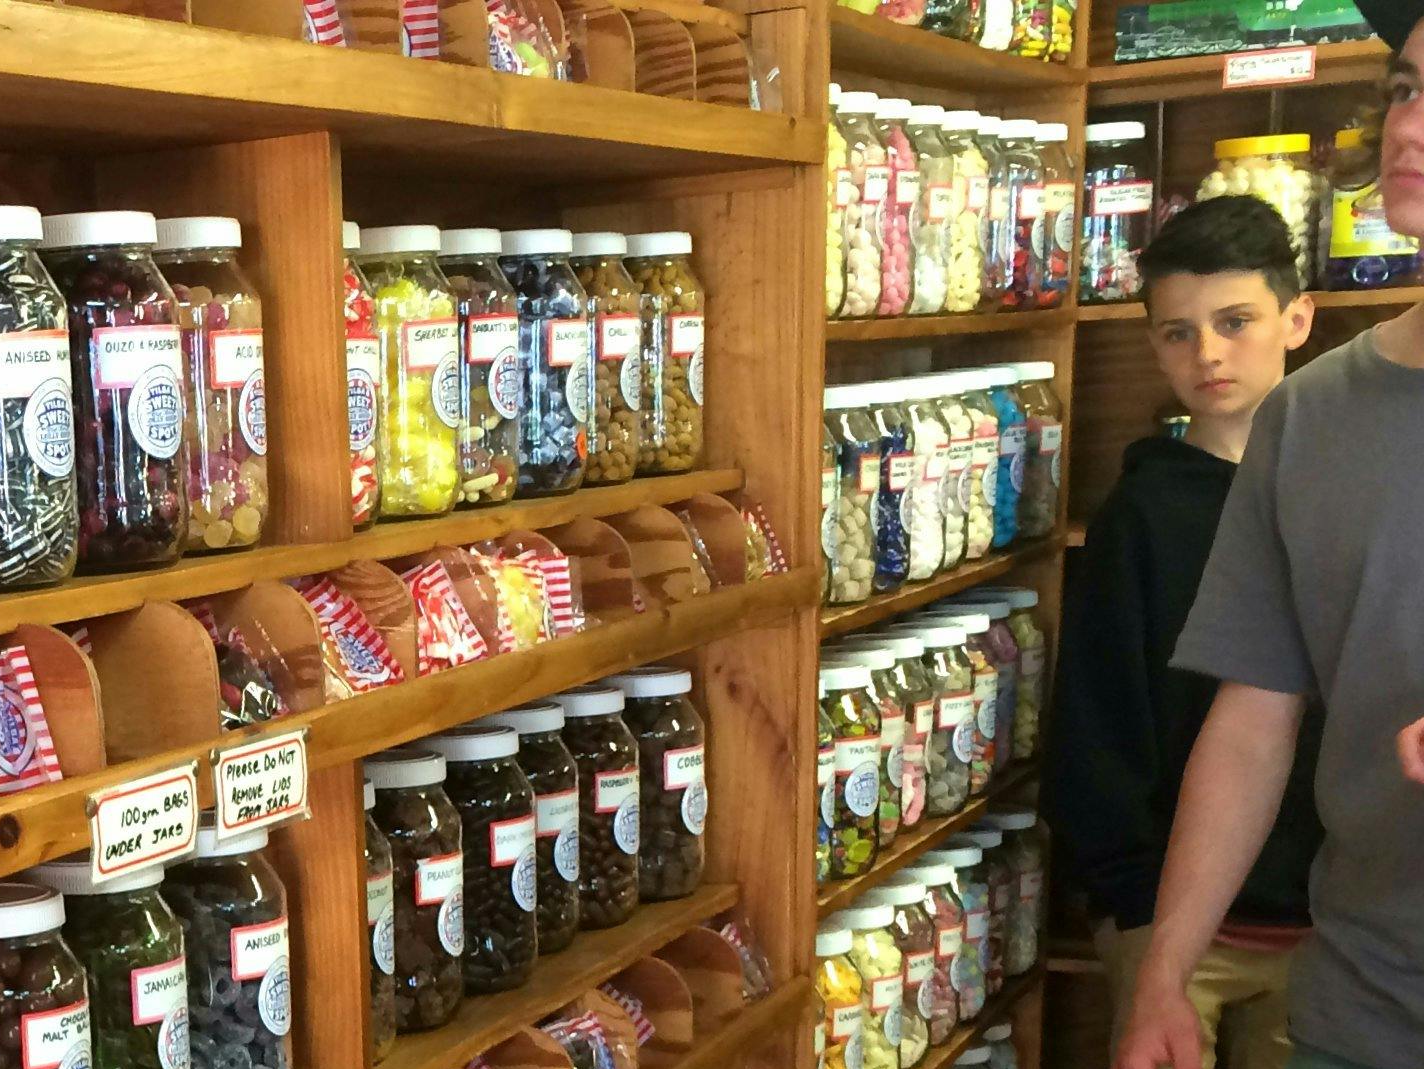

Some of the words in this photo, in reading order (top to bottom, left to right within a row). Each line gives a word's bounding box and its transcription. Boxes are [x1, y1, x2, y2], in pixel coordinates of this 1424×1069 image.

[105, 340, 135, 353] OUZO
[5, 350, 52, 364] ANISEED
[145, 395, 176, 411] SWEET
[39, 411, 70, 427] SWEET
[149, 425, 176, 440] SPOT
[350, 422, 369, 435] POT
[46, 443, 70, 458] SPOT
[231, 783, 264, 804] REMOVE
[272, 775, 292, 795] LIDS
[163, 790, 189, 813] BAGS
[265, 794, 290, 816] JARS
[105, 833, 143, 862] UNDER
[152, 822, 184, 845] JARS
[245, 933, 281, 951] ANISEED
[42, 1029, 69, 1042] MALT
